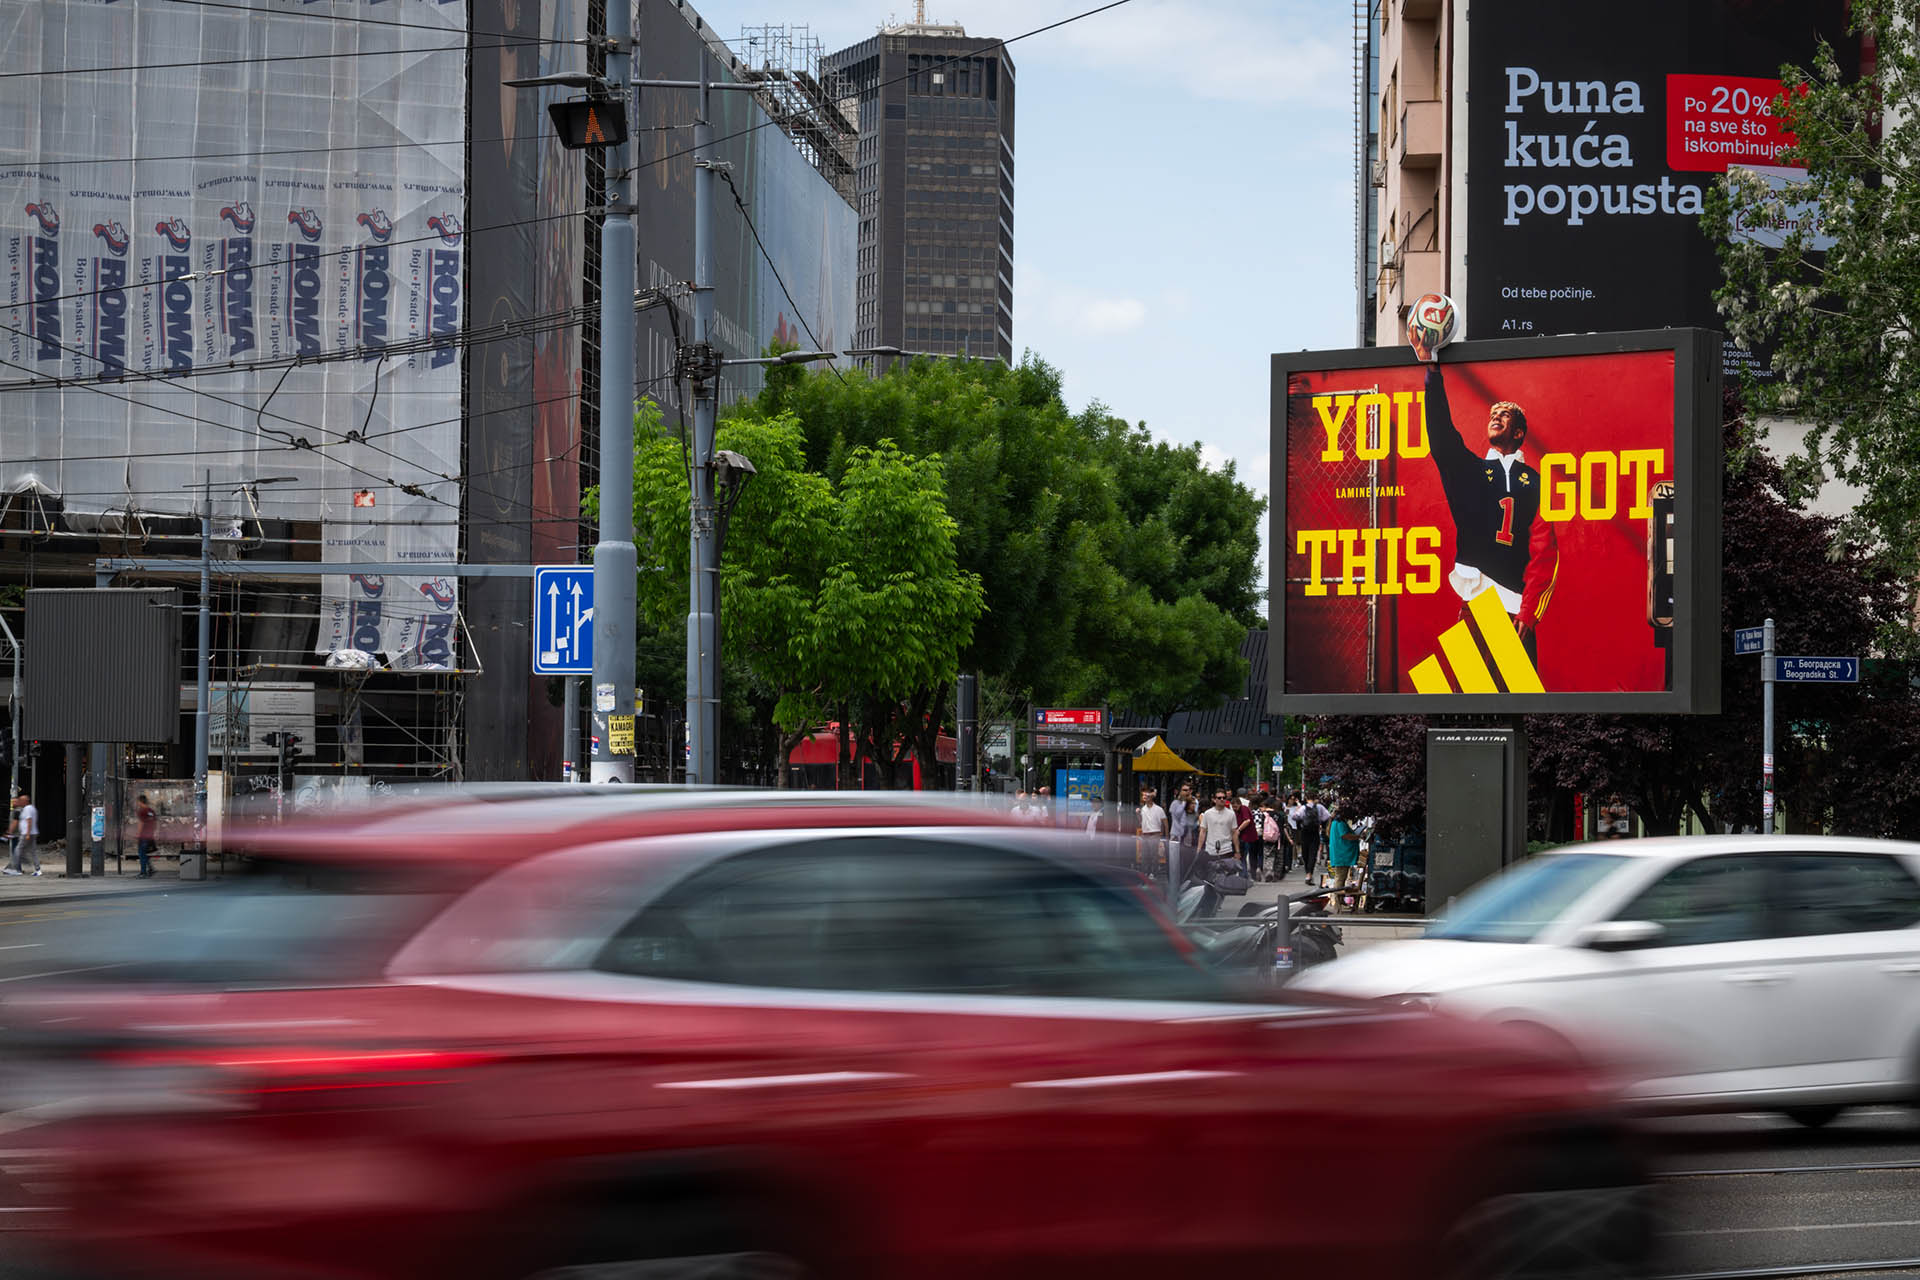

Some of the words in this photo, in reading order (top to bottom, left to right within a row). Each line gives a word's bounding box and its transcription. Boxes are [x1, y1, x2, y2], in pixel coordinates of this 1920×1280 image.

[1505, 67, 1644, 114] Puna
[1684, 97, 1707, 112] Po
[1711, 86, 1774, 117] 20%
[1504, 120, 1634, 168] kuća
[1684, 120, 1706, 133] na
[1710, 122, 1738, 134] sve
[1741, 119, 1767, 136] što
[1504, 176, 1705, 226] popusta
[9, 237, 20, 265] Boje
[74, 257, 87, 285] Boje
[203, 242, 216, 271] Boje
[408, 248, 421, 280] Boje
[34, 236, 62, 361] ROMA
[141, 292, 153, 336] Fasade
[227, 237, 255, 357] ROMA
[269, 275, 281, 316] Fasade
[294, 243, 321, 361] ROMA
[338, 277, 349, 319] Fasade
[408, 283, 421, 324] Fasade
[1501, 287, 1519, 298] Od
[1521, 287, 1548, 298] tebe
[1549, 287, 1596, 301] počinje.
[99, 257, 127, 384] ROMA
[269, 322, 281, 360] Tapete
[1501, 319, 1533, 330] A1.rs
[204, 322, 216, 362] Tapete
[1312, 391, 1431, 462] YOU
[1336, 487, 1372, 499] LAMINE
[1374, 485, 1406, 497] YAMAL
[1540, 448, 1665, 522] GOT
[1495, 496, 1515, 547] 1
[1296, 526, 1441, 597] THIS
[1783, 660, 1796, 670] ул.
[1798, 659, 1841, 670] Београдска
[1785, 670, 1826, 680] Beogradska
[1828, 670, 1839, 679] St.
